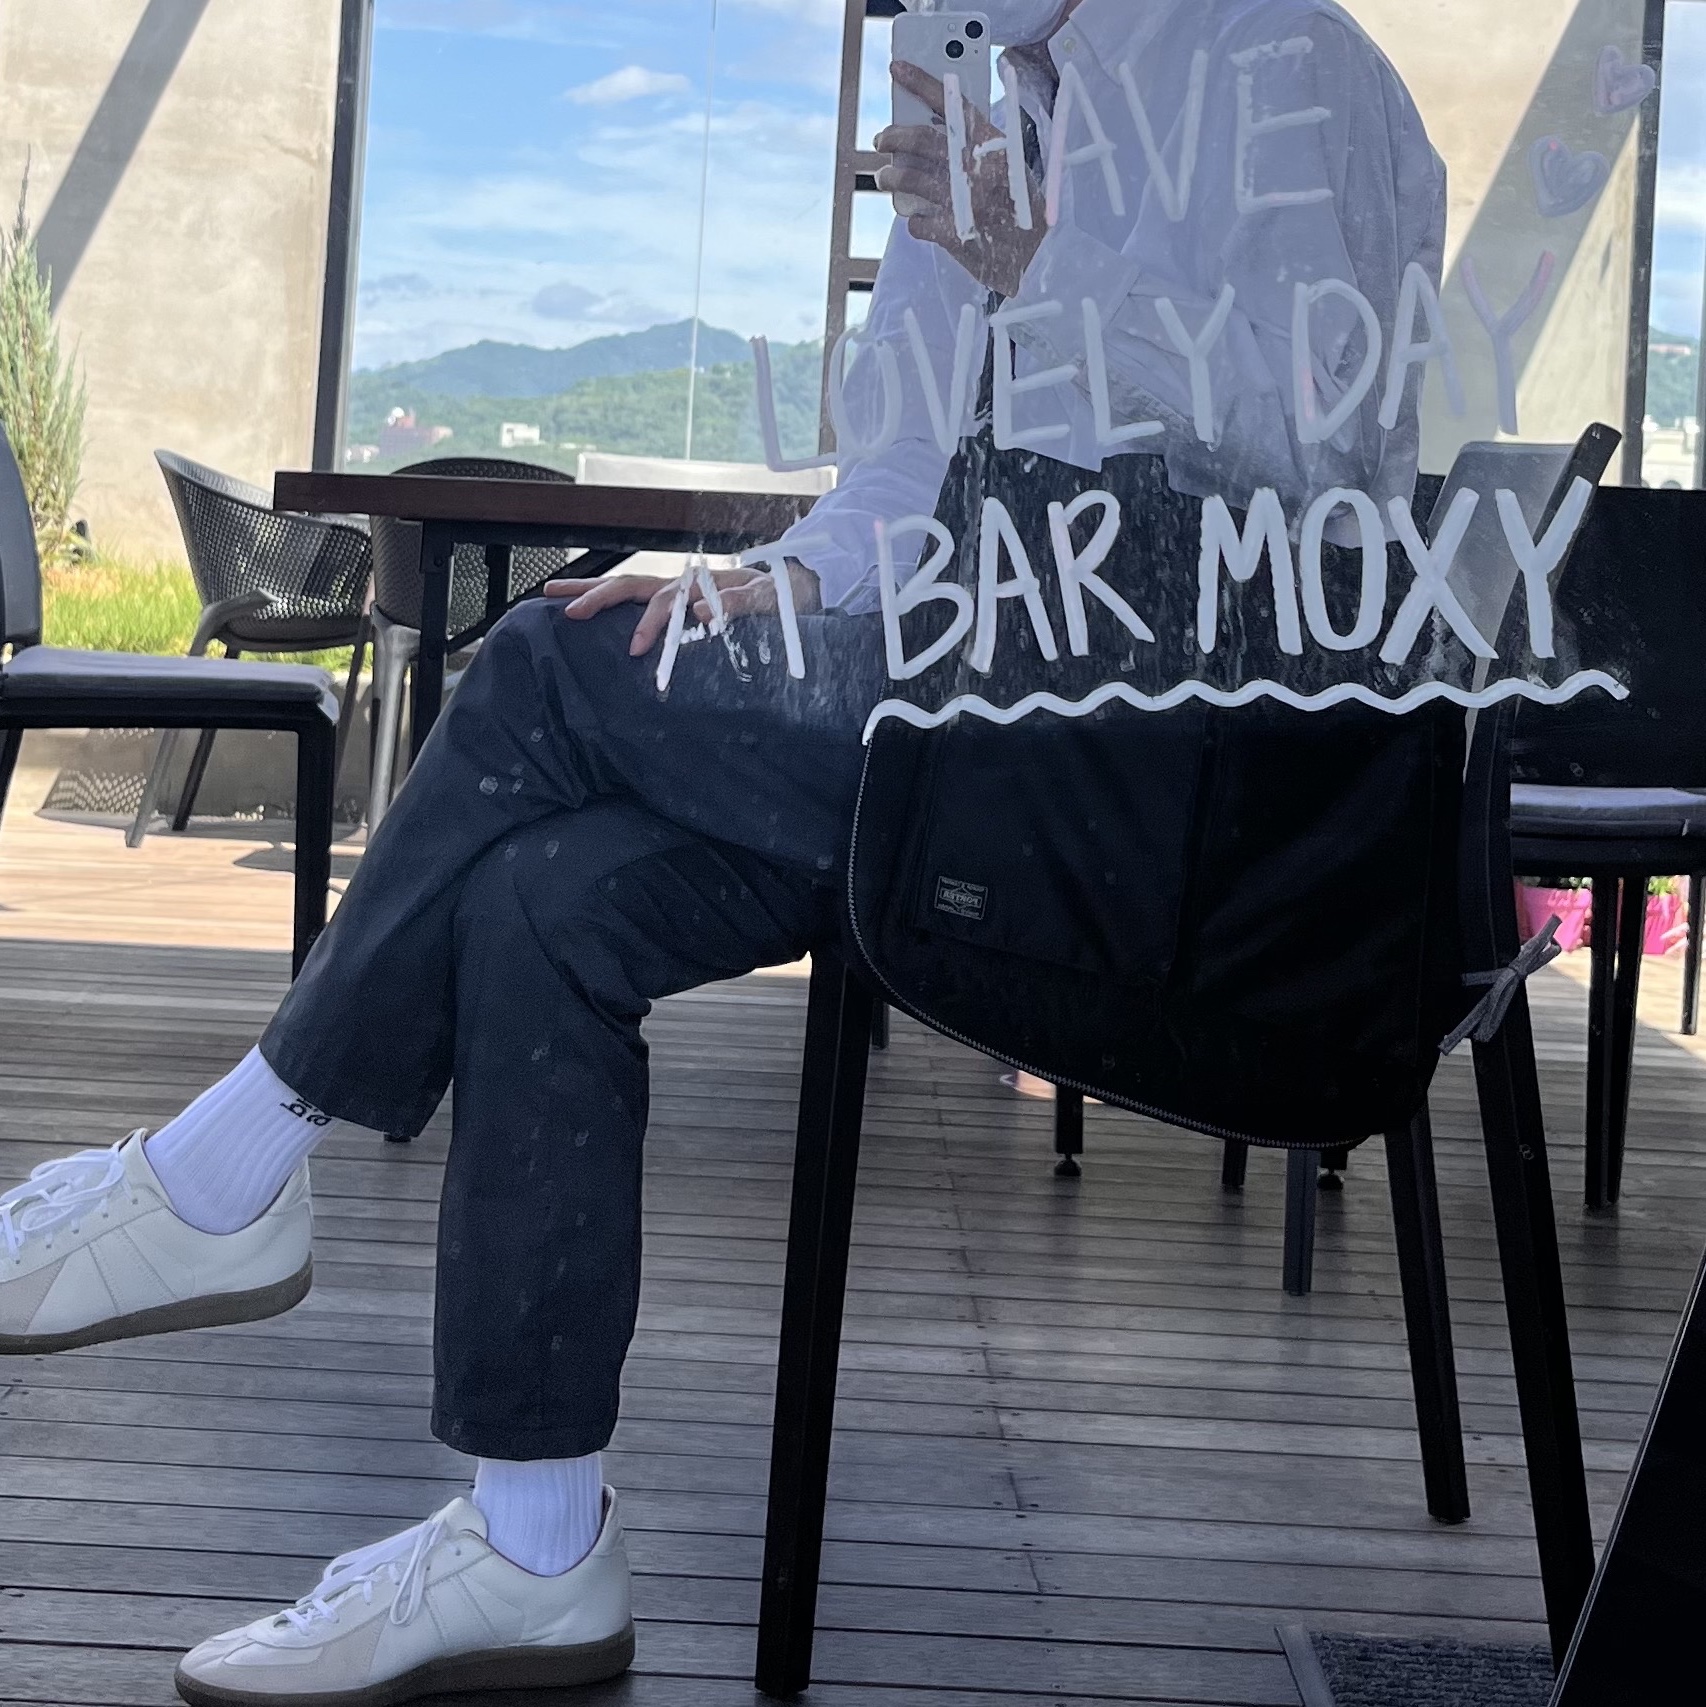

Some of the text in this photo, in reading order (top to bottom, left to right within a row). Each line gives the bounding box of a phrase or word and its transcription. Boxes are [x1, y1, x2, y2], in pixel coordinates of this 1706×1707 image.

[942, 36, 1334, 242] HAVE
[749, 249, 1556, 473] LOVELY DAY
[656, 476, 1593, 692] AT BAR MOXY
